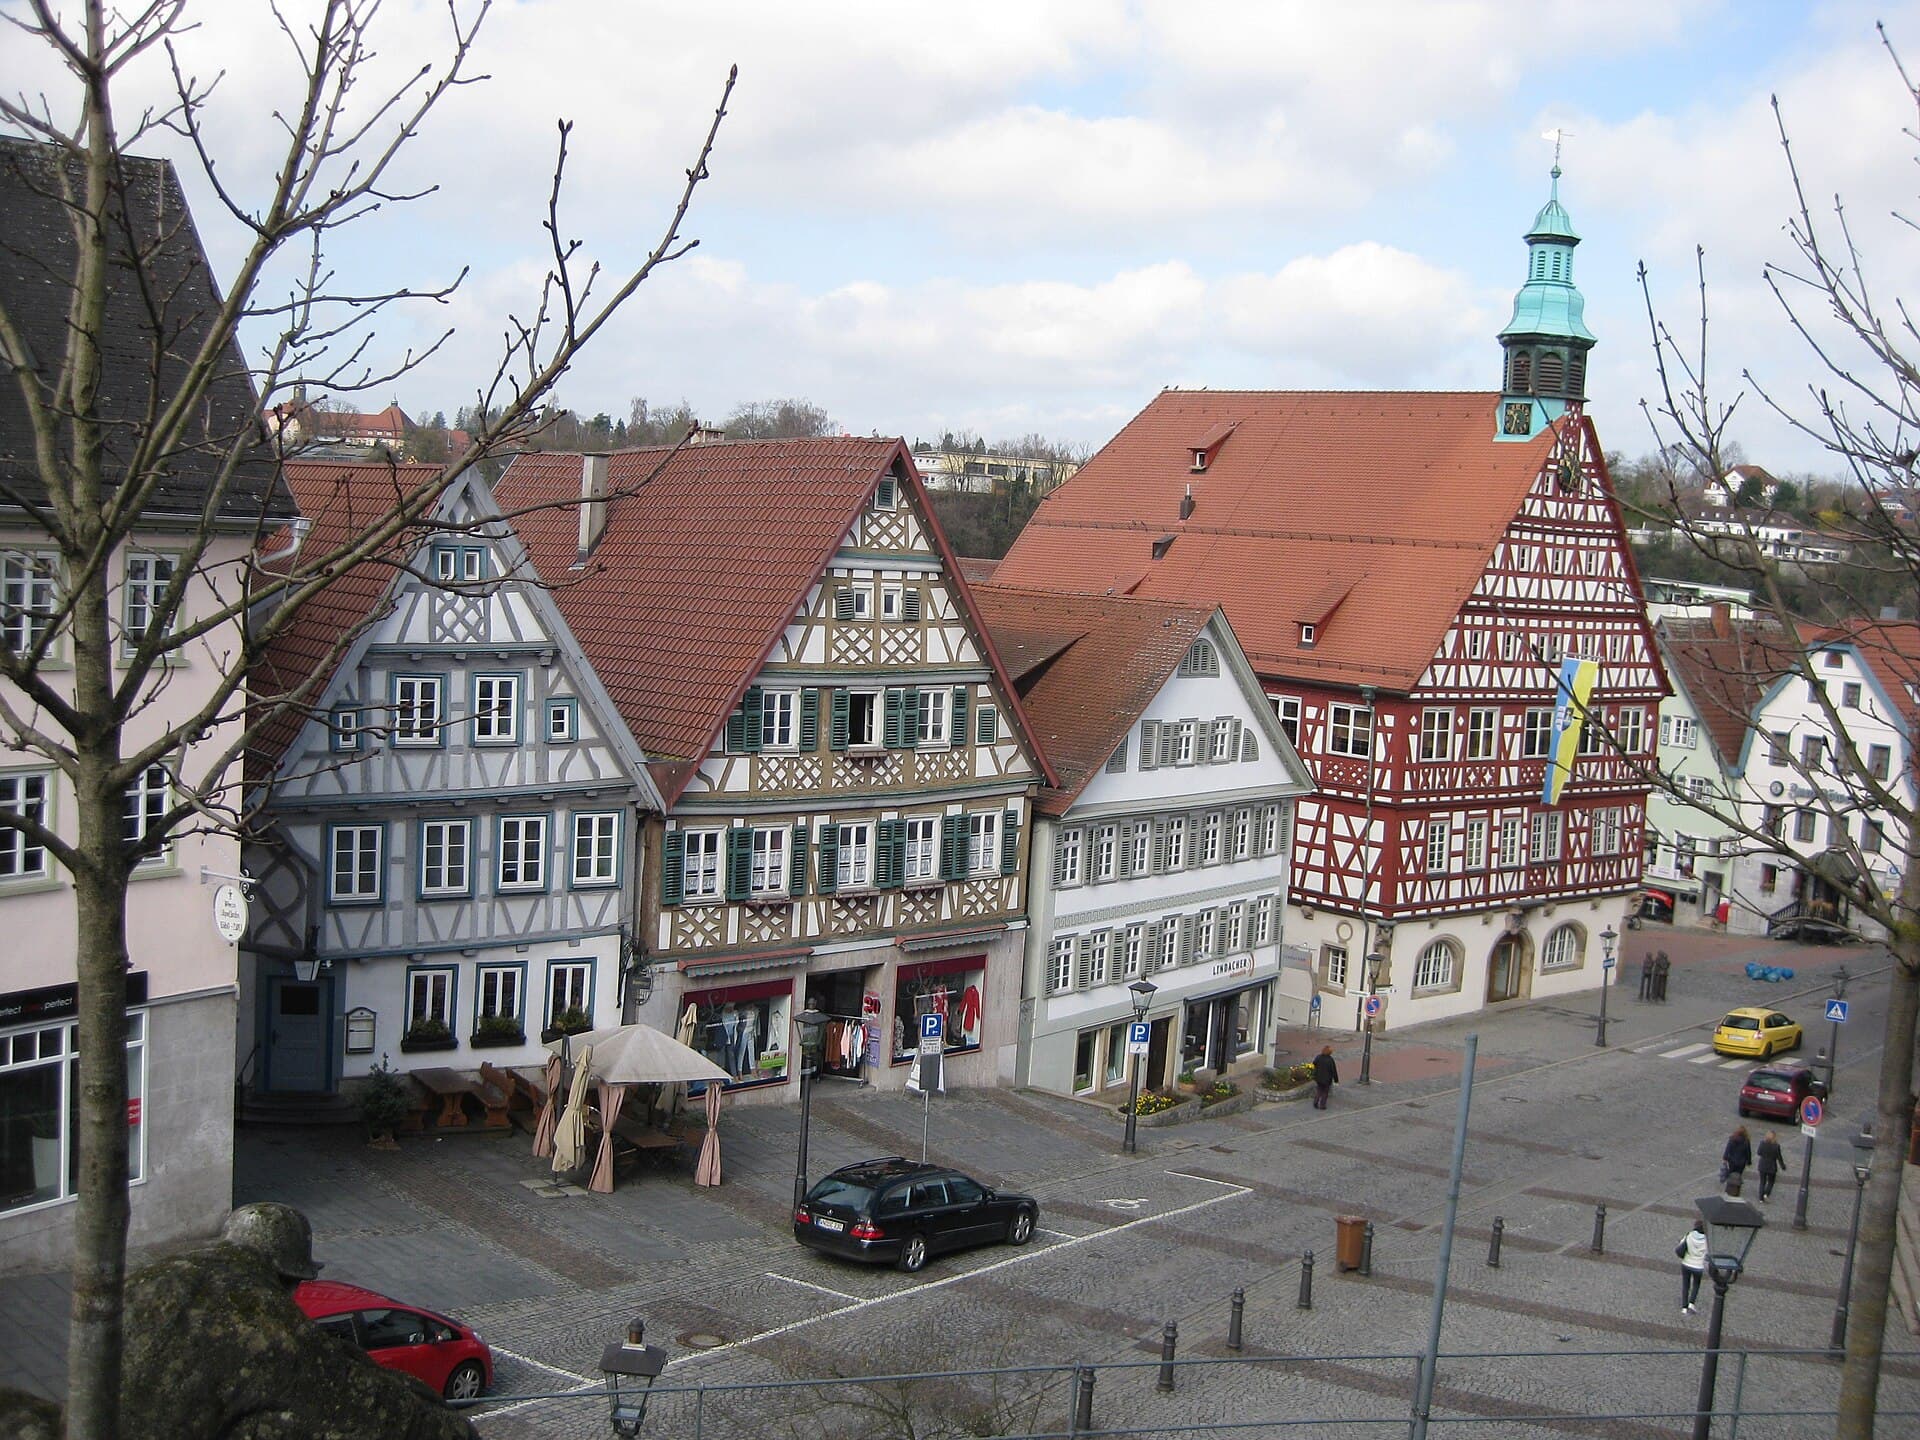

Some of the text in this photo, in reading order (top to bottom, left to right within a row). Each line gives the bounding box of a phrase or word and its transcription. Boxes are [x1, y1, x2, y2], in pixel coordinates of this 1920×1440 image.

[44, 998, 73, 1012] perfect
[926, 1017, 937, 1035] P
[1134, 1025, 1146, 1041] P
